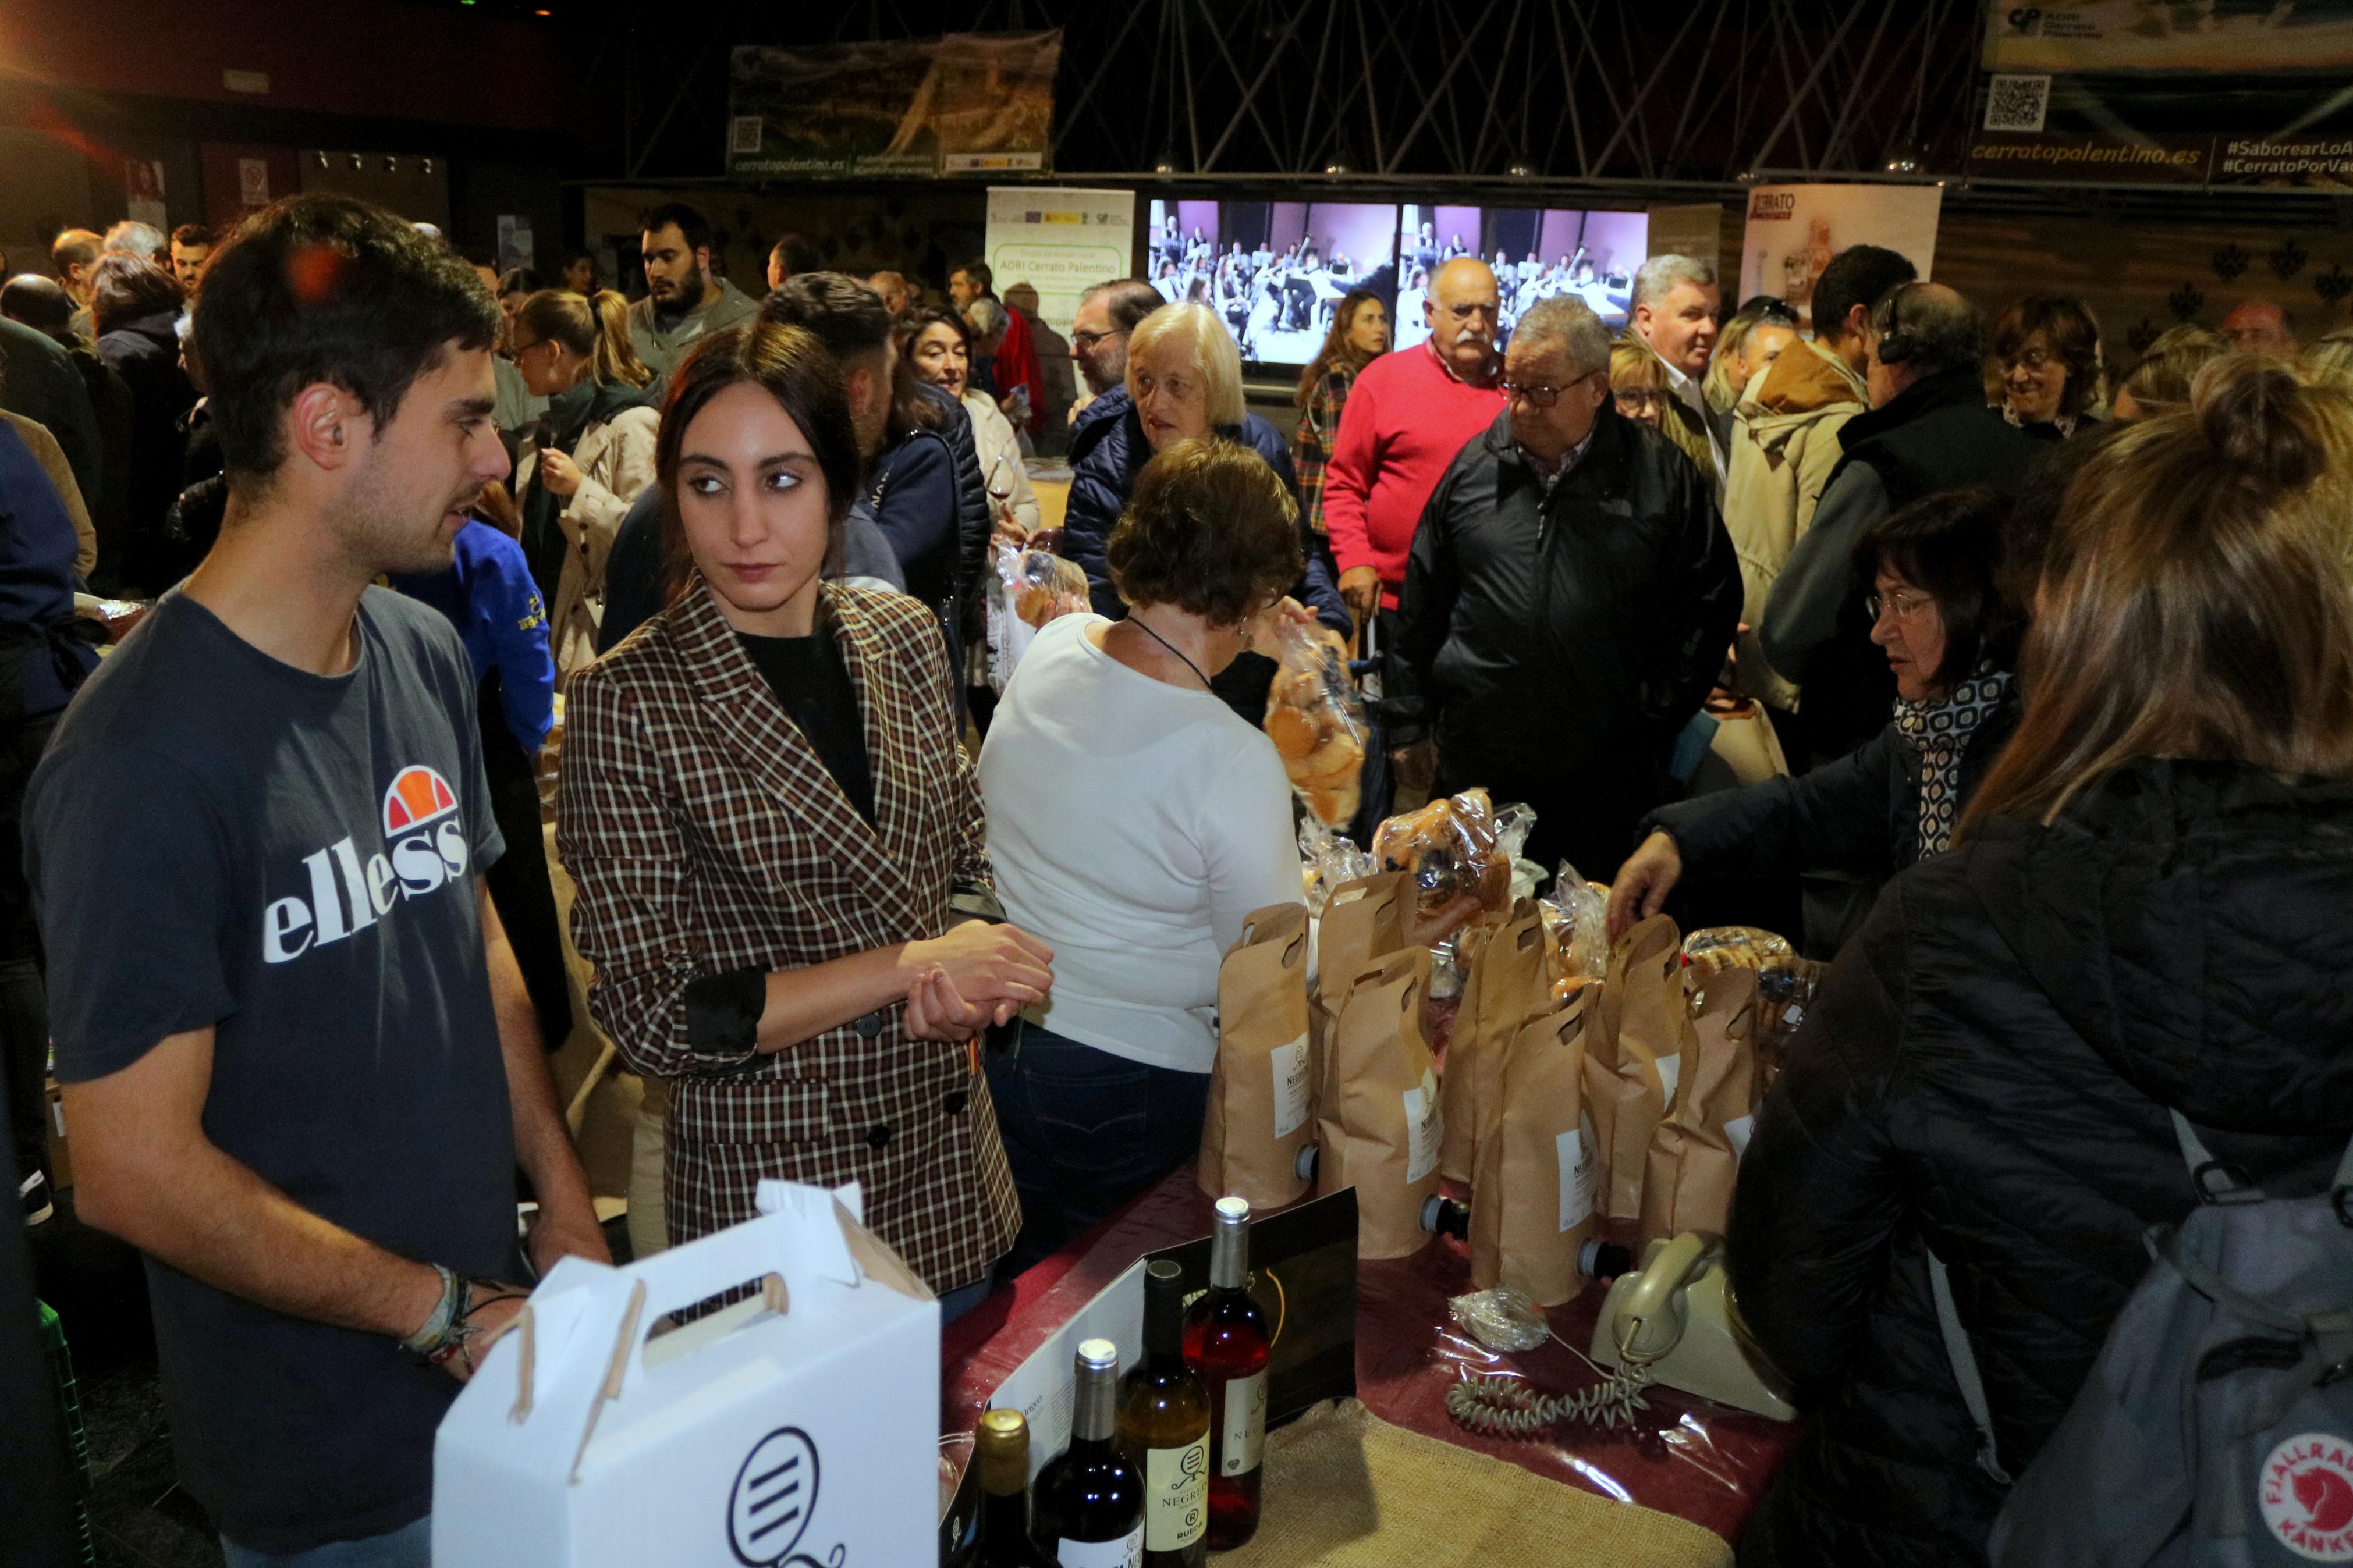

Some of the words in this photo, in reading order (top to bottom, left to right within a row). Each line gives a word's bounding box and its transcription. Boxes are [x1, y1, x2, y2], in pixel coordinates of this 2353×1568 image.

[1971, 141, 2201, 165] cerratopalentino.es
[735, 157, 845, 173] cerratopalentino.es
[1000, 260, 1025, 271] ADRI
[1028, 261, 1064, 272] Cerrato
[1068, 261, 1115, 273] Palentino
[1177, 1520, 1203, 1539] RUEDA
